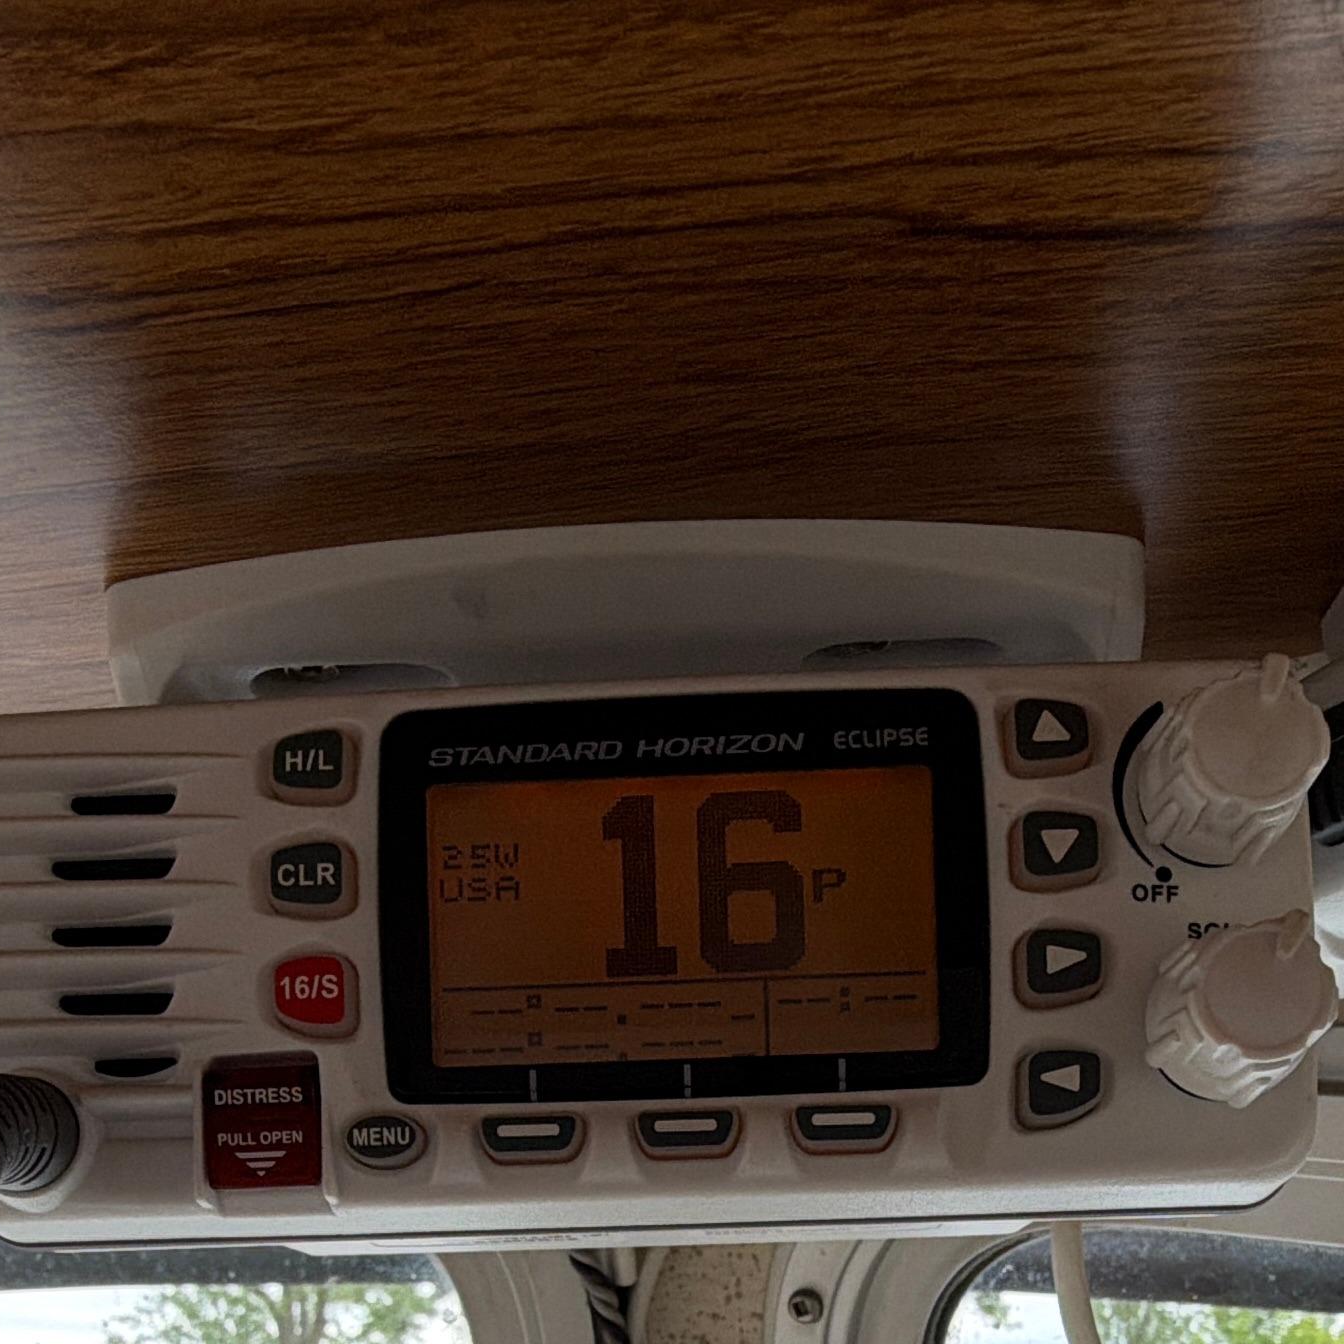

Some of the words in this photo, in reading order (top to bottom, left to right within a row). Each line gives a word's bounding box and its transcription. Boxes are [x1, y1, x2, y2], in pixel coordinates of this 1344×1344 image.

[428, 740, 624, 768] STANDARD
[636, 732, 806, 760] HORIZON
[832, 727, 929, 750] ECLIPSE
[284, 748, 335, 773] H/L
[441, 842, 521, 871] 25W
[276, 862, 337, 887] CLR
[601, 789, 808, 978] 16
[811, 867, 848, 905] P
[438, 875, 522, 903] USA
[1131, 883, 1180, 904] OFF
[279, 974, 340, 1000] 16/S
[213, 1086, 304, 1106] DISTRESS
[216, 1131, 257, 1147] PULL
[258, 1129, 304, 1146] OPEN
[352, 1125, 411, 1147] MENU
